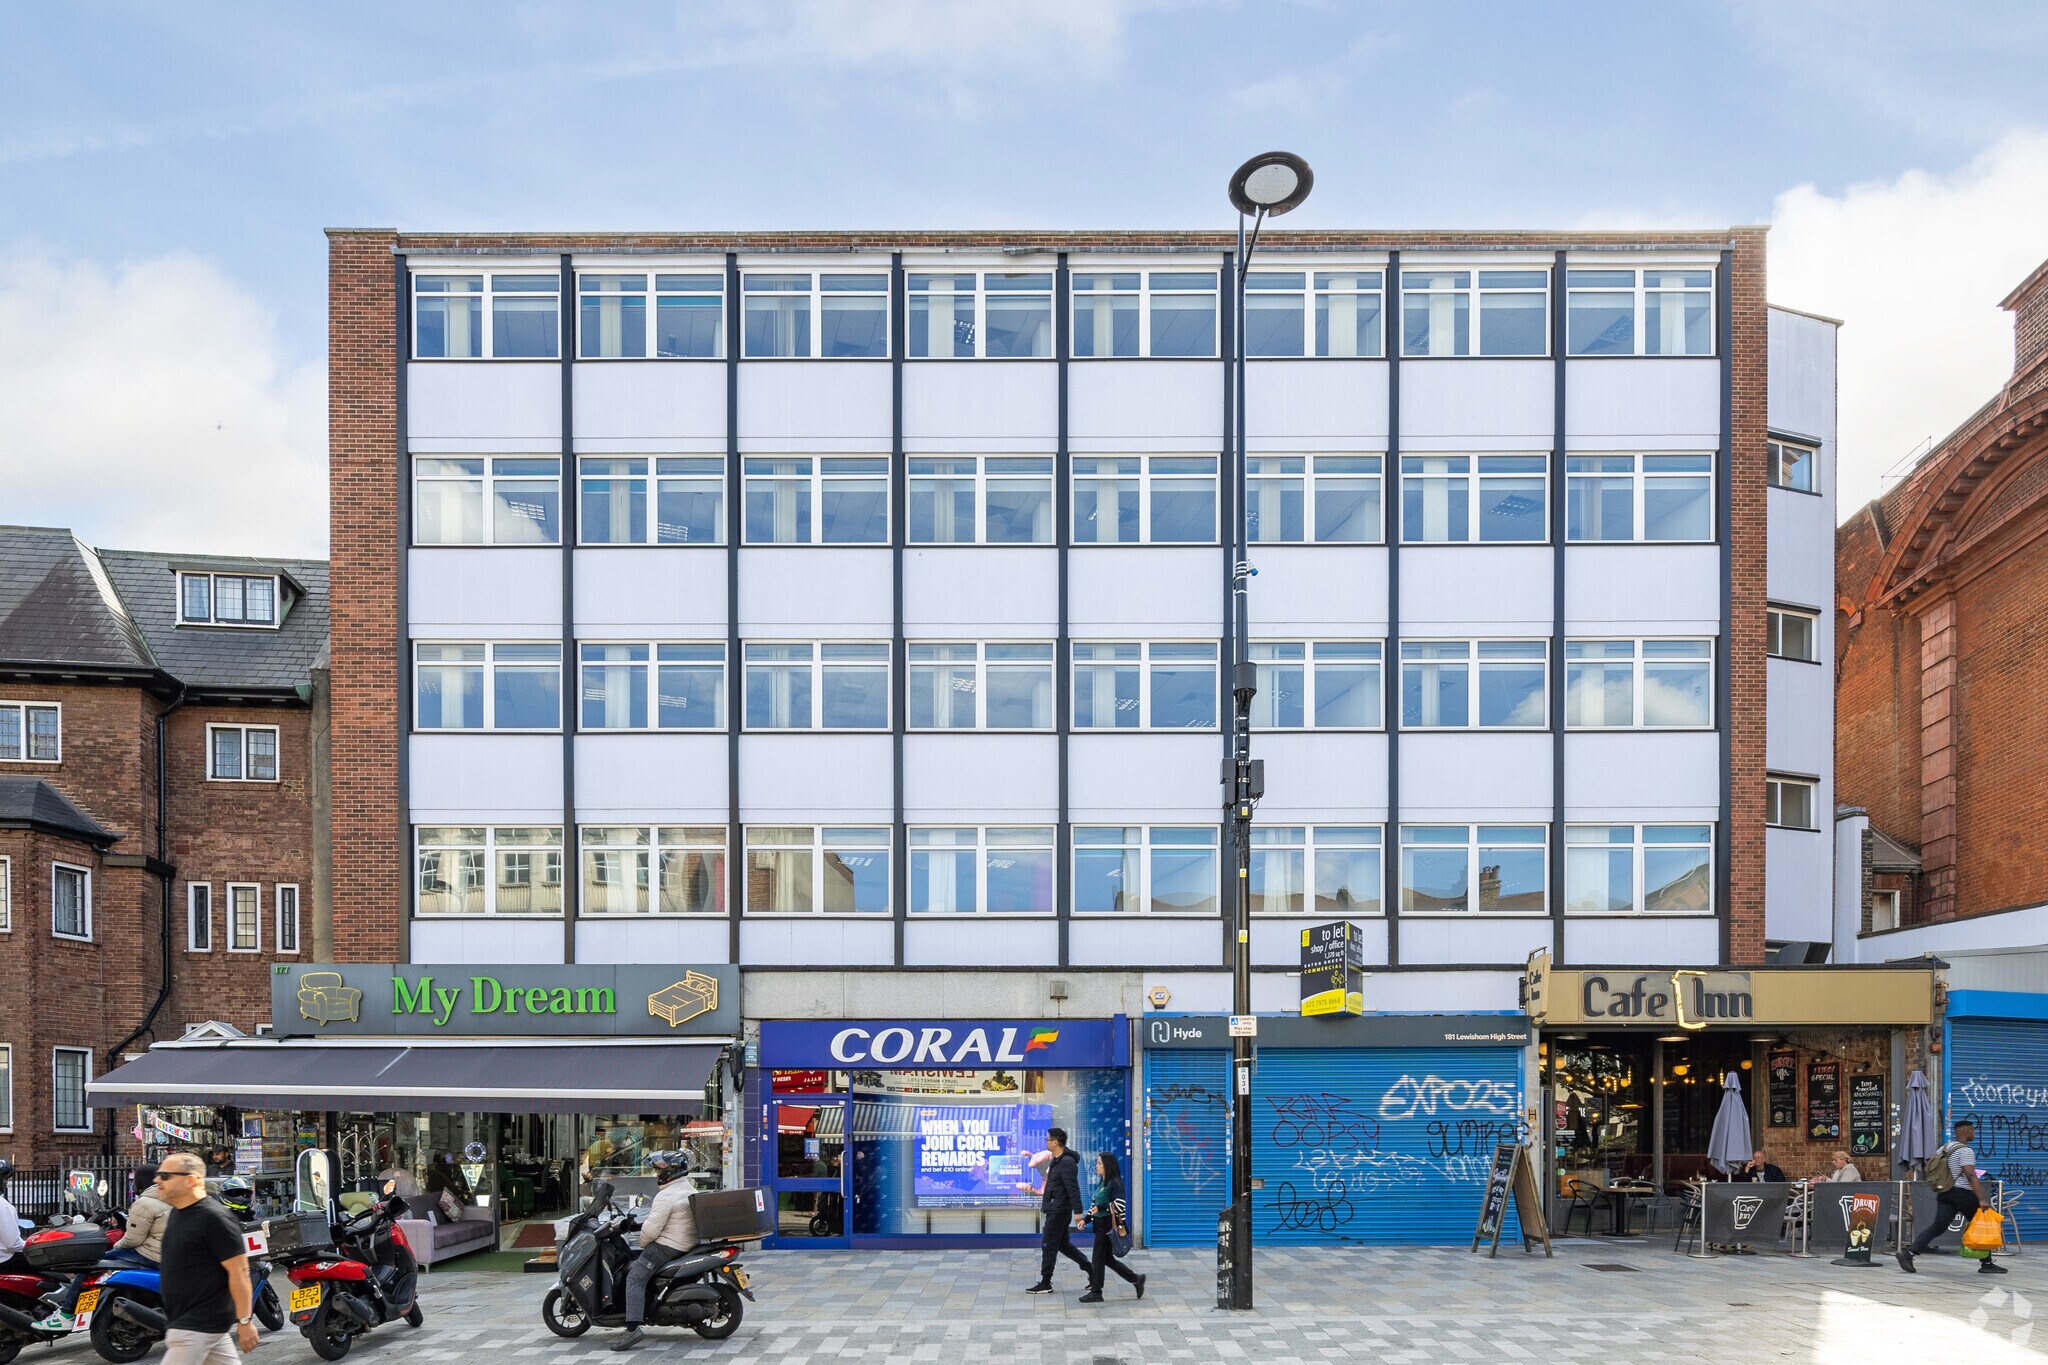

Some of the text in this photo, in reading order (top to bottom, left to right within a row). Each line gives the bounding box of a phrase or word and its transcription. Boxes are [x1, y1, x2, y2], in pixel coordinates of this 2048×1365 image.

[1322, 930, 1331, 941] to
[1333, 925, 1344, 939] let
[1310, 944, 1324, 954] shop
[1328, 940, 1344, 950] office
[275, 966, 289, 974] 177
[1304, 964, 1342, 974] COMMERCIAL
[1529, 971, 1542, 986] Cafe
[391, 977, 616, 1026] My Dream
[1531, 988, 1540, 1001] Inn
[1583, 976, 1753, 1018] Cafe Inn
[1173, 1027, 1202, 1040] Hyde
[1490, 1033, 1506, 1042] High
[830, 1027, 1024, 1063] CORAL
[1529, 1108, 1536, 1120] H
[921, 1119, 989, 1136] WHEN YOU
[921, 1135, 1000, 1151] JOIN CORAL
[921, 1151, 986, 1166] REWARDS
[1853, 1198, 1878, 1213] DRURY
[247, 1236, 262, 1251] L
[79, 1292, 99, 1302] PF69
[291, 1287, 319, 1300] LB23
[77, 1301, 94, 1313] CZP
[295, 1297, 315, 1309] CCT
[76, 1313, 86, 1327] L
